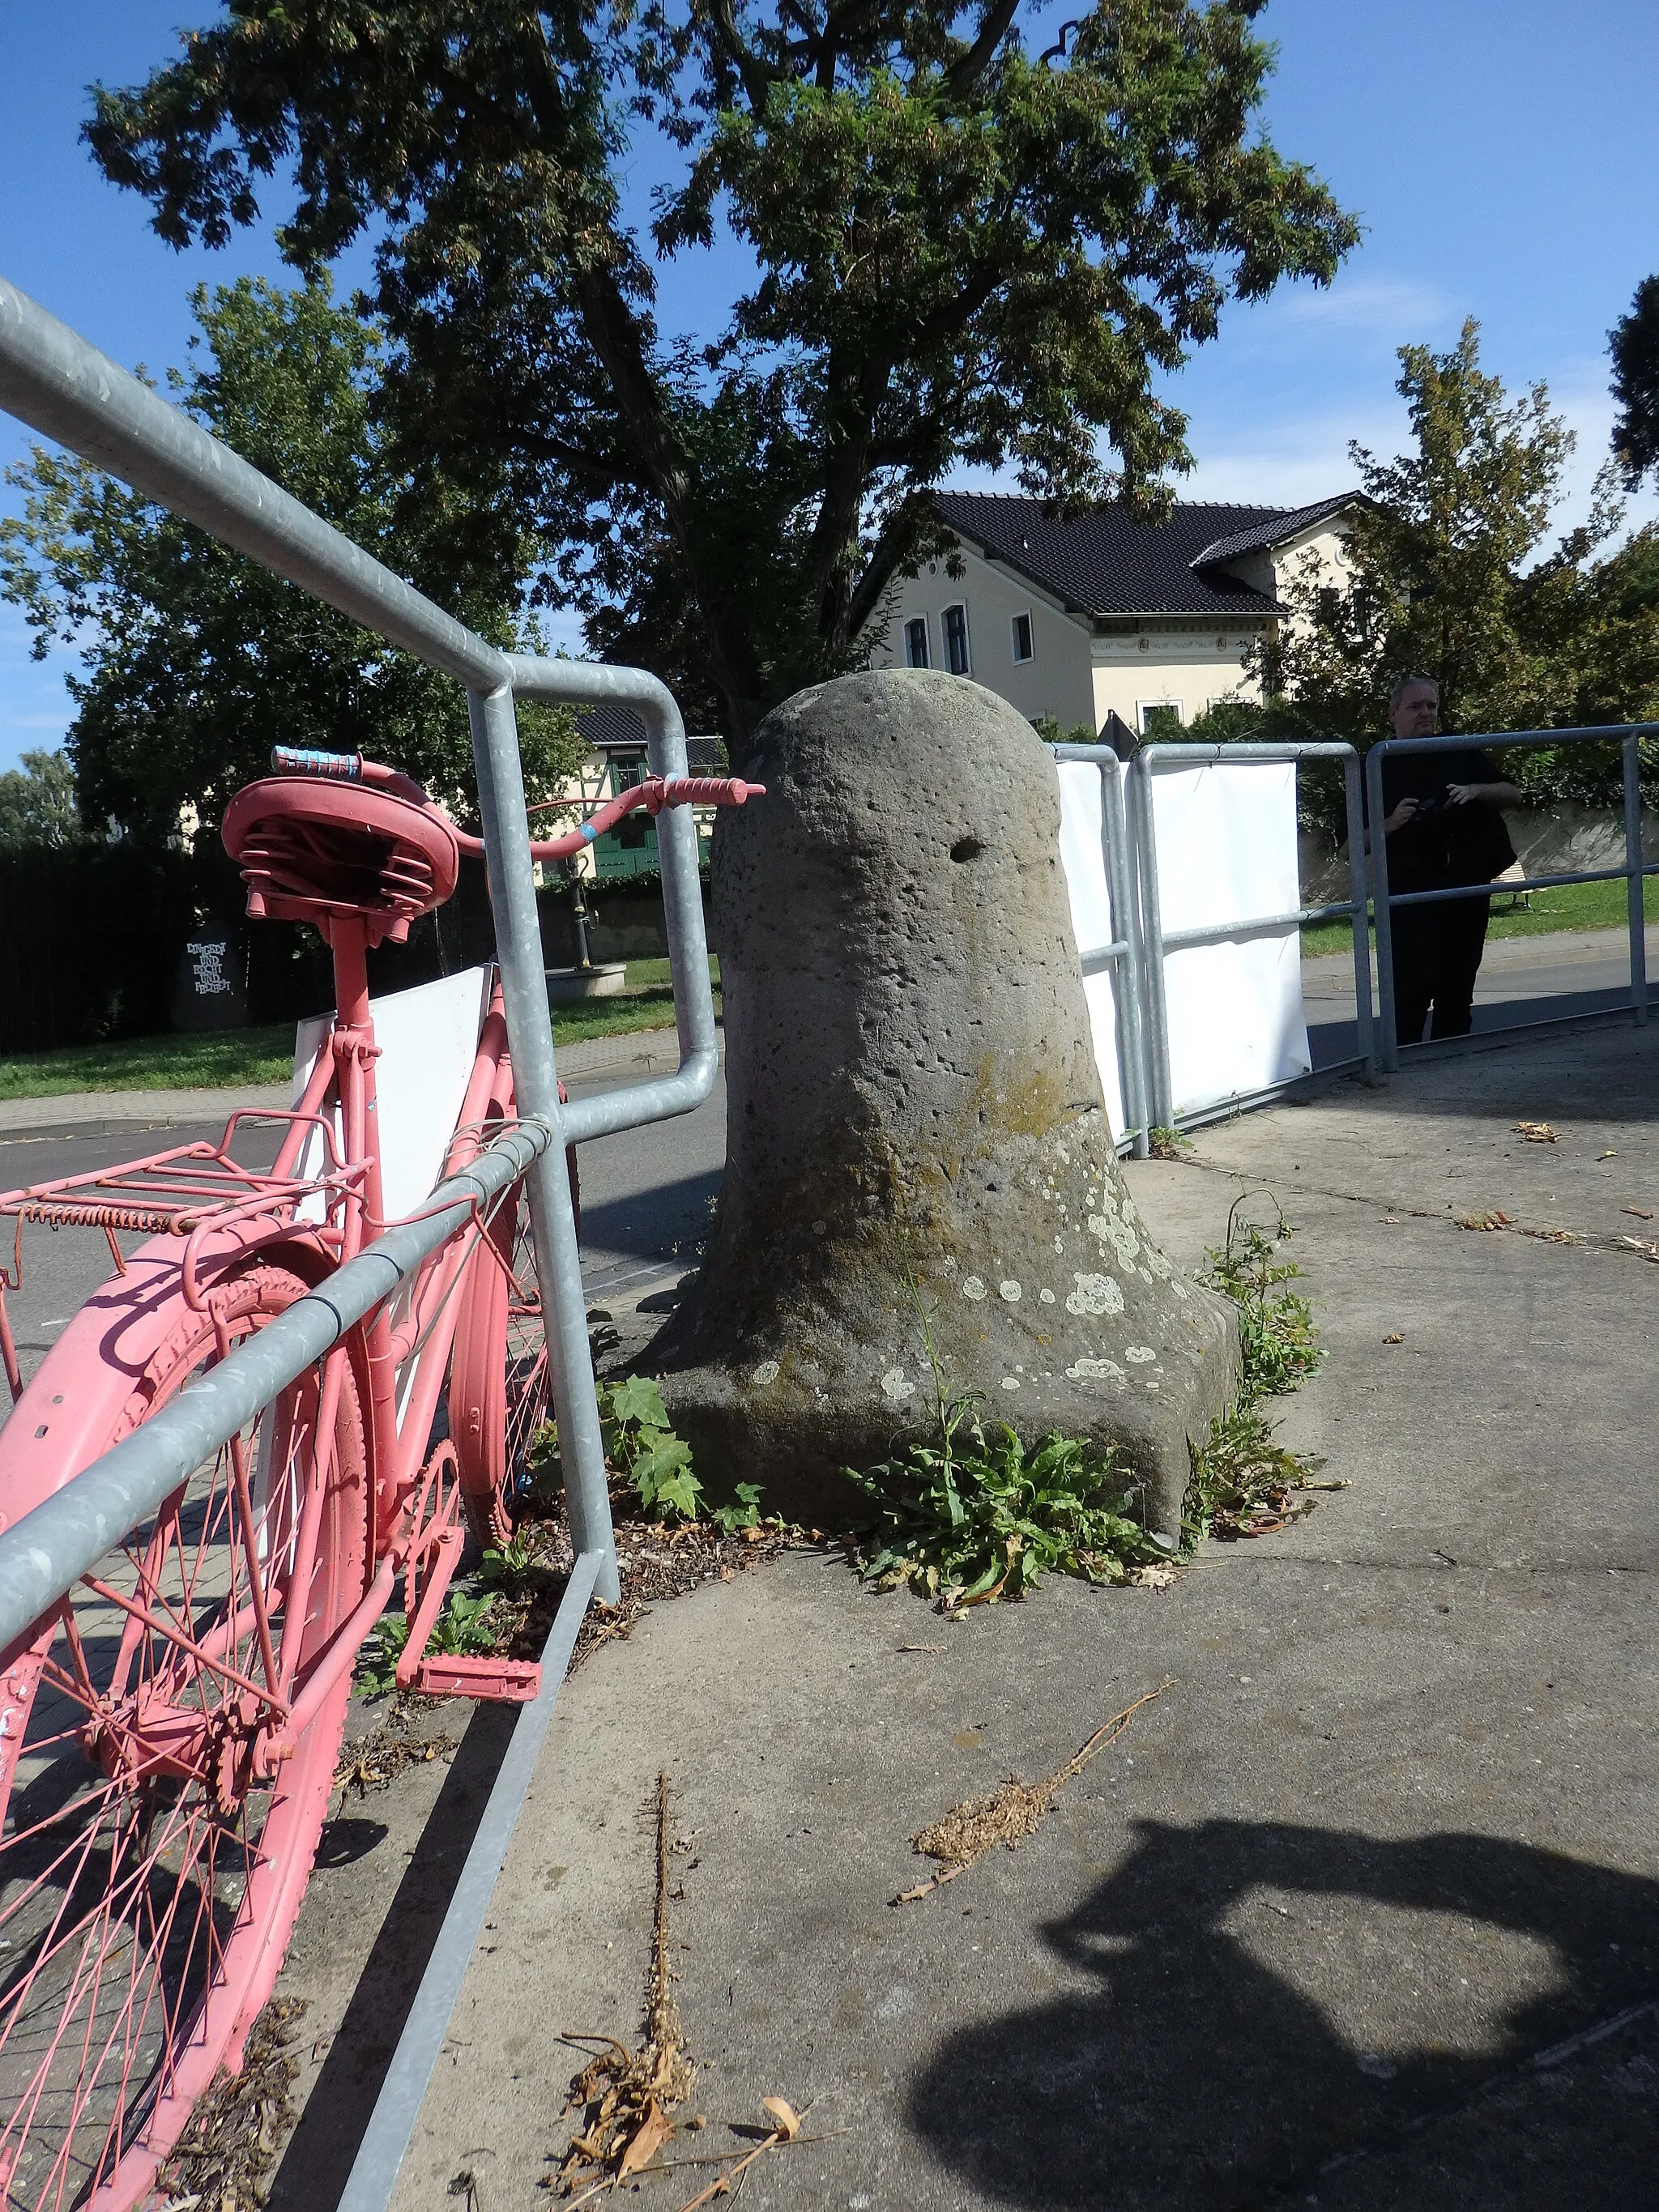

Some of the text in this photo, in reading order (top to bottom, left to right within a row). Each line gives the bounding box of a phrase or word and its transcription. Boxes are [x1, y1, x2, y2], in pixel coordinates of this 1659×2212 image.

[199, 956, 220, 965] UND
[193, 964, 223, 974] RECHT
[200, 974, 220, 983] UND
[195, 979, 231, 994] FREIHEIT
